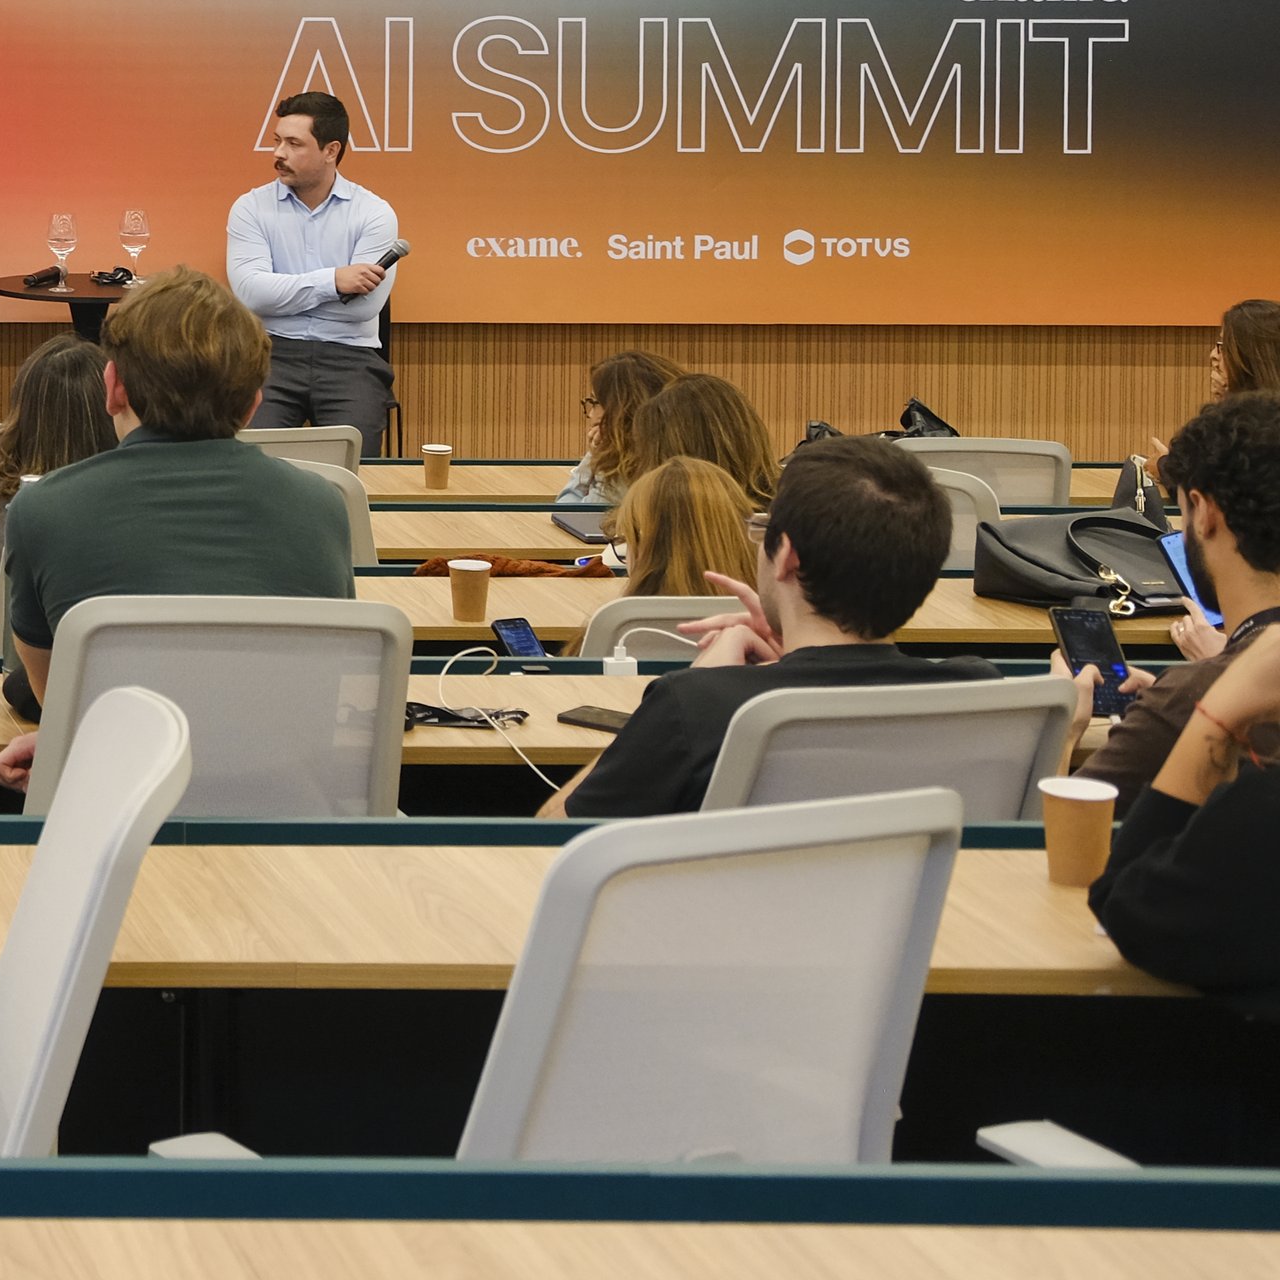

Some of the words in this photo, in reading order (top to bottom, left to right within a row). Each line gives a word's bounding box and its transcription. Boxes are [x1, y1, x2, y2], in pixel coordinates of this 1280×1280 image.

[253, 16, 414, 153] AI
[451, 14, 1130, 155] SUMMIT
[466, 234, 583, 258] exame.
[607, 233, 685, 260] Saint
[693, 234, 759, 260] Paul
[820, 236, 911, 259] TOTVS
